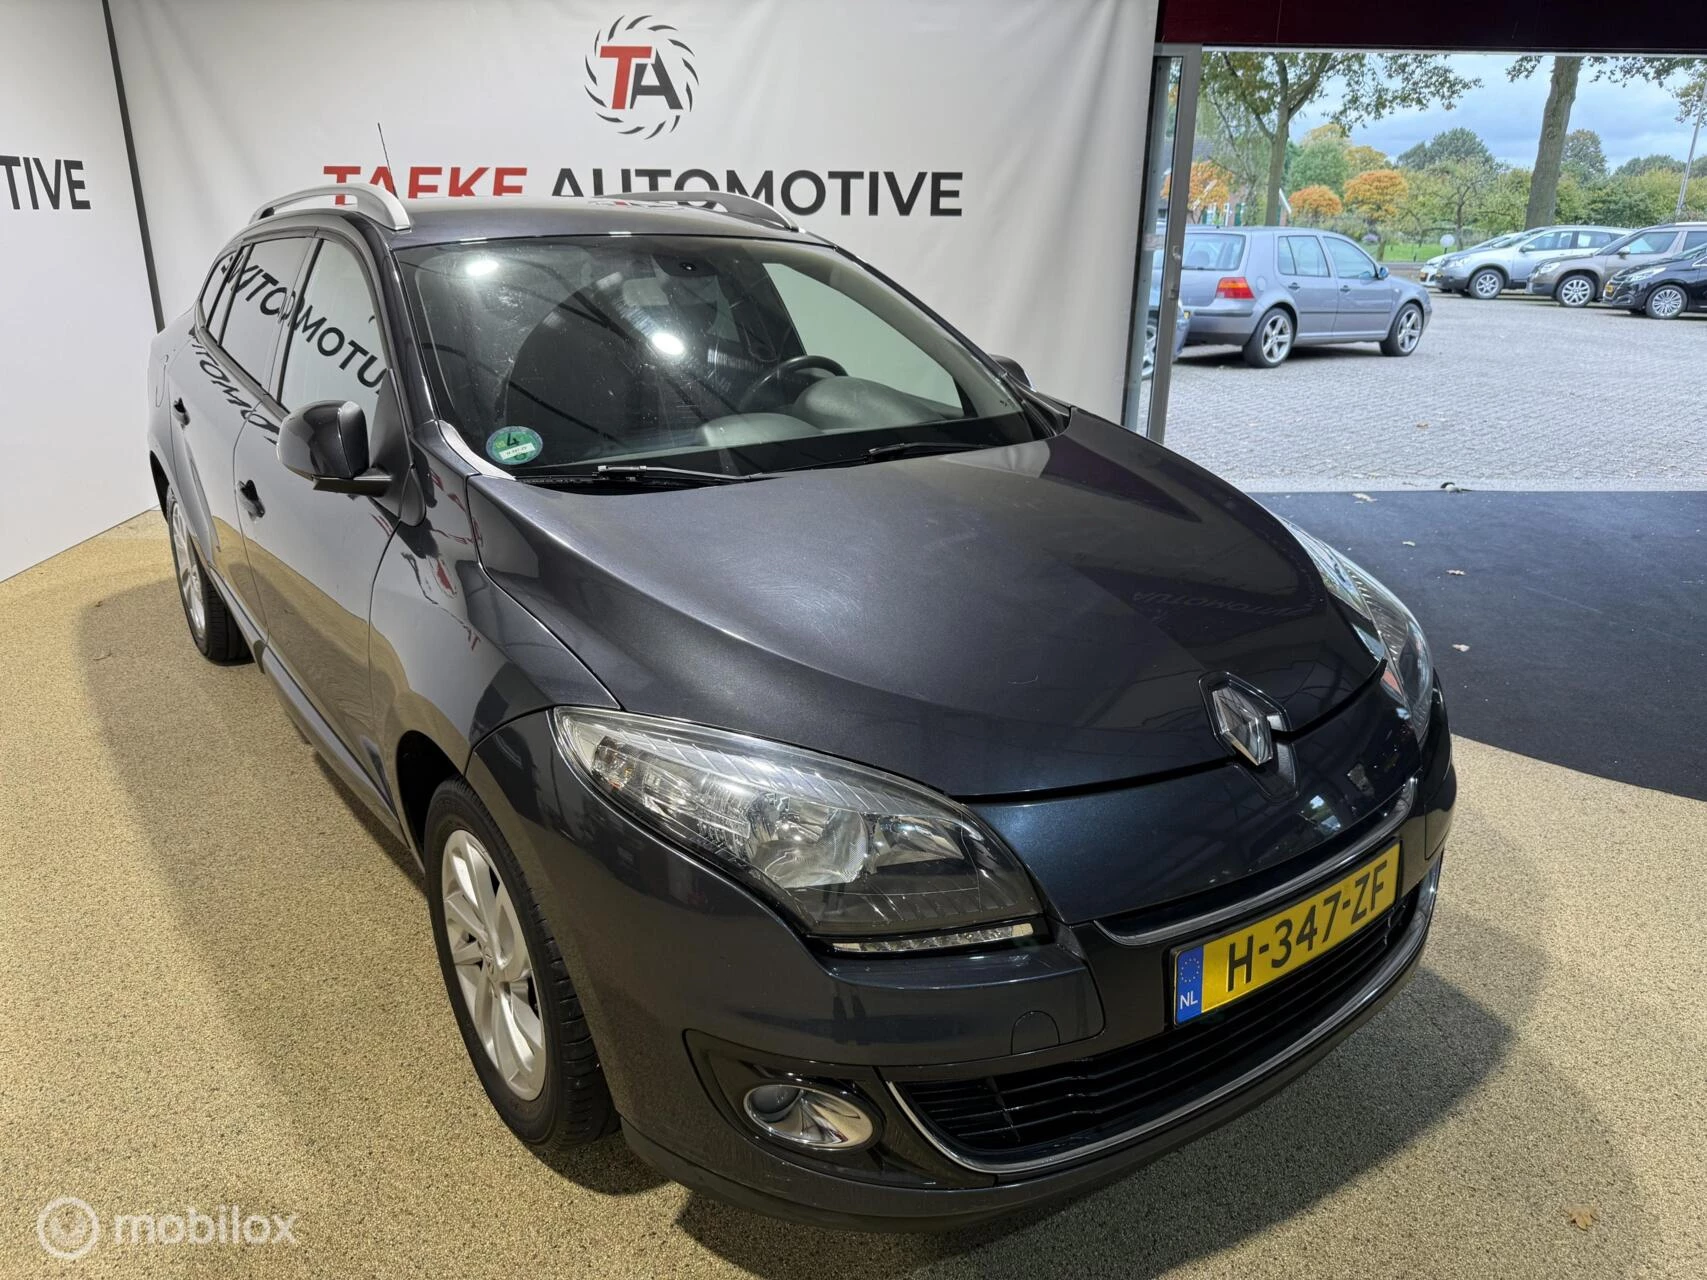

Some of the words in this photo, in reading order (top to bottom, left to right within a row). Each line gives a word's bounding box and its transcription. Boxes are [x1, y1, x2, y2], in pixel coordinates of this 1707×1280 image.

[600, 46, 683, 109] TA
[0, 155, 91, 210] TIVE
[1226, 860, 1388, 993] H-347-ZF
[1180, 997, 1199, 1010] NL
